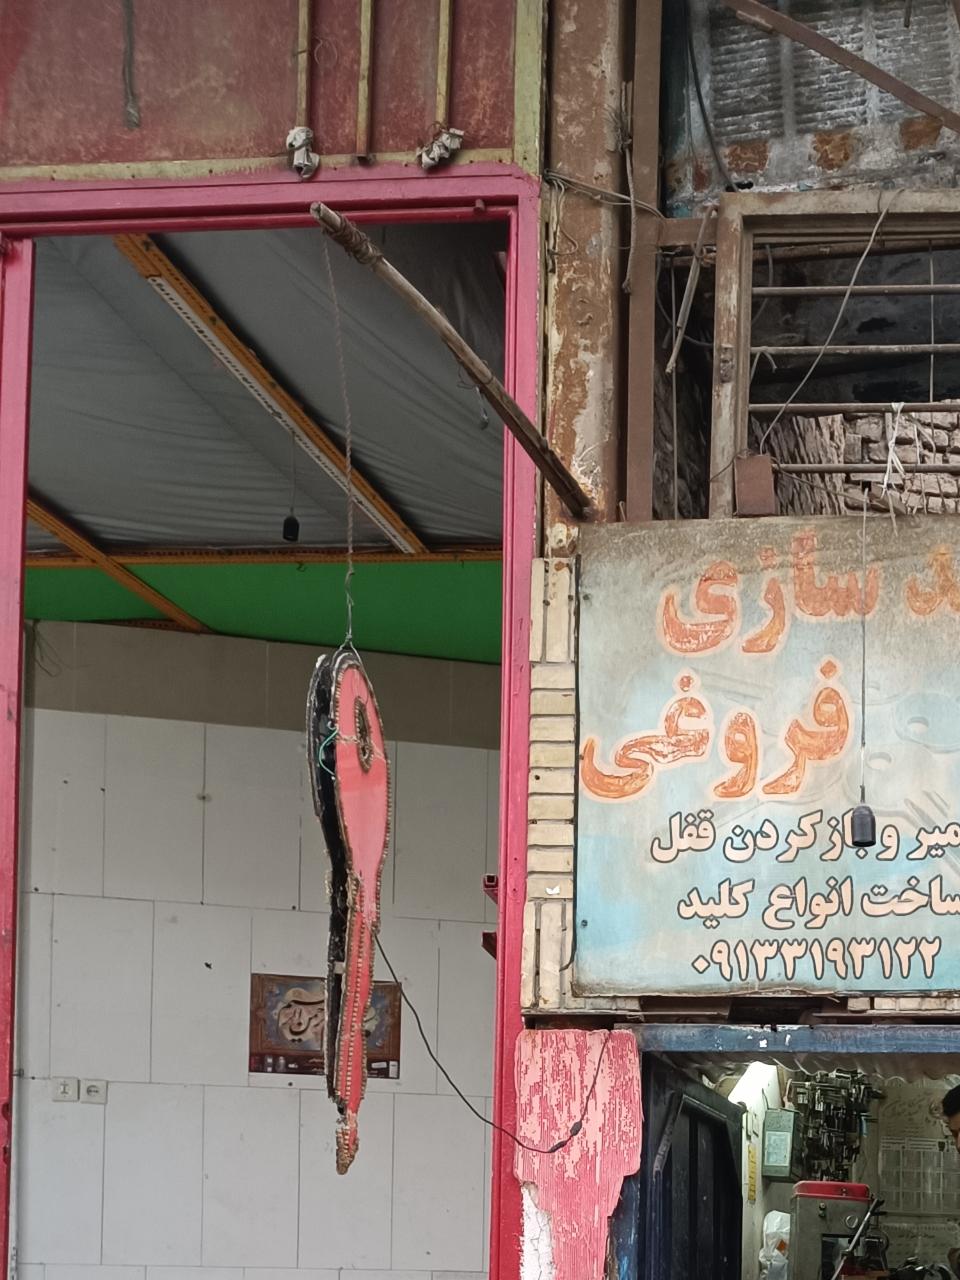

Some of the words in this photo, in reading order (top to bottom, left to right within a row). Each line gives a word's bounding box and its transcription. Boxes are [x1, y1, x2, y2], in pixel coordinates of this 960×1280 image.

[660, 528, 882, 656] سازی
[578, 658, 851, 800] فروغی
[650, 808, 717, 864] قفل
[875, 823, 901, 862] و
[676, 876, 756, 930] کلید
[761, 874, 853, 931] انواع
[690, 934, 943, 982] ۰۹۱۳۳۱۹۳۱۲۲
